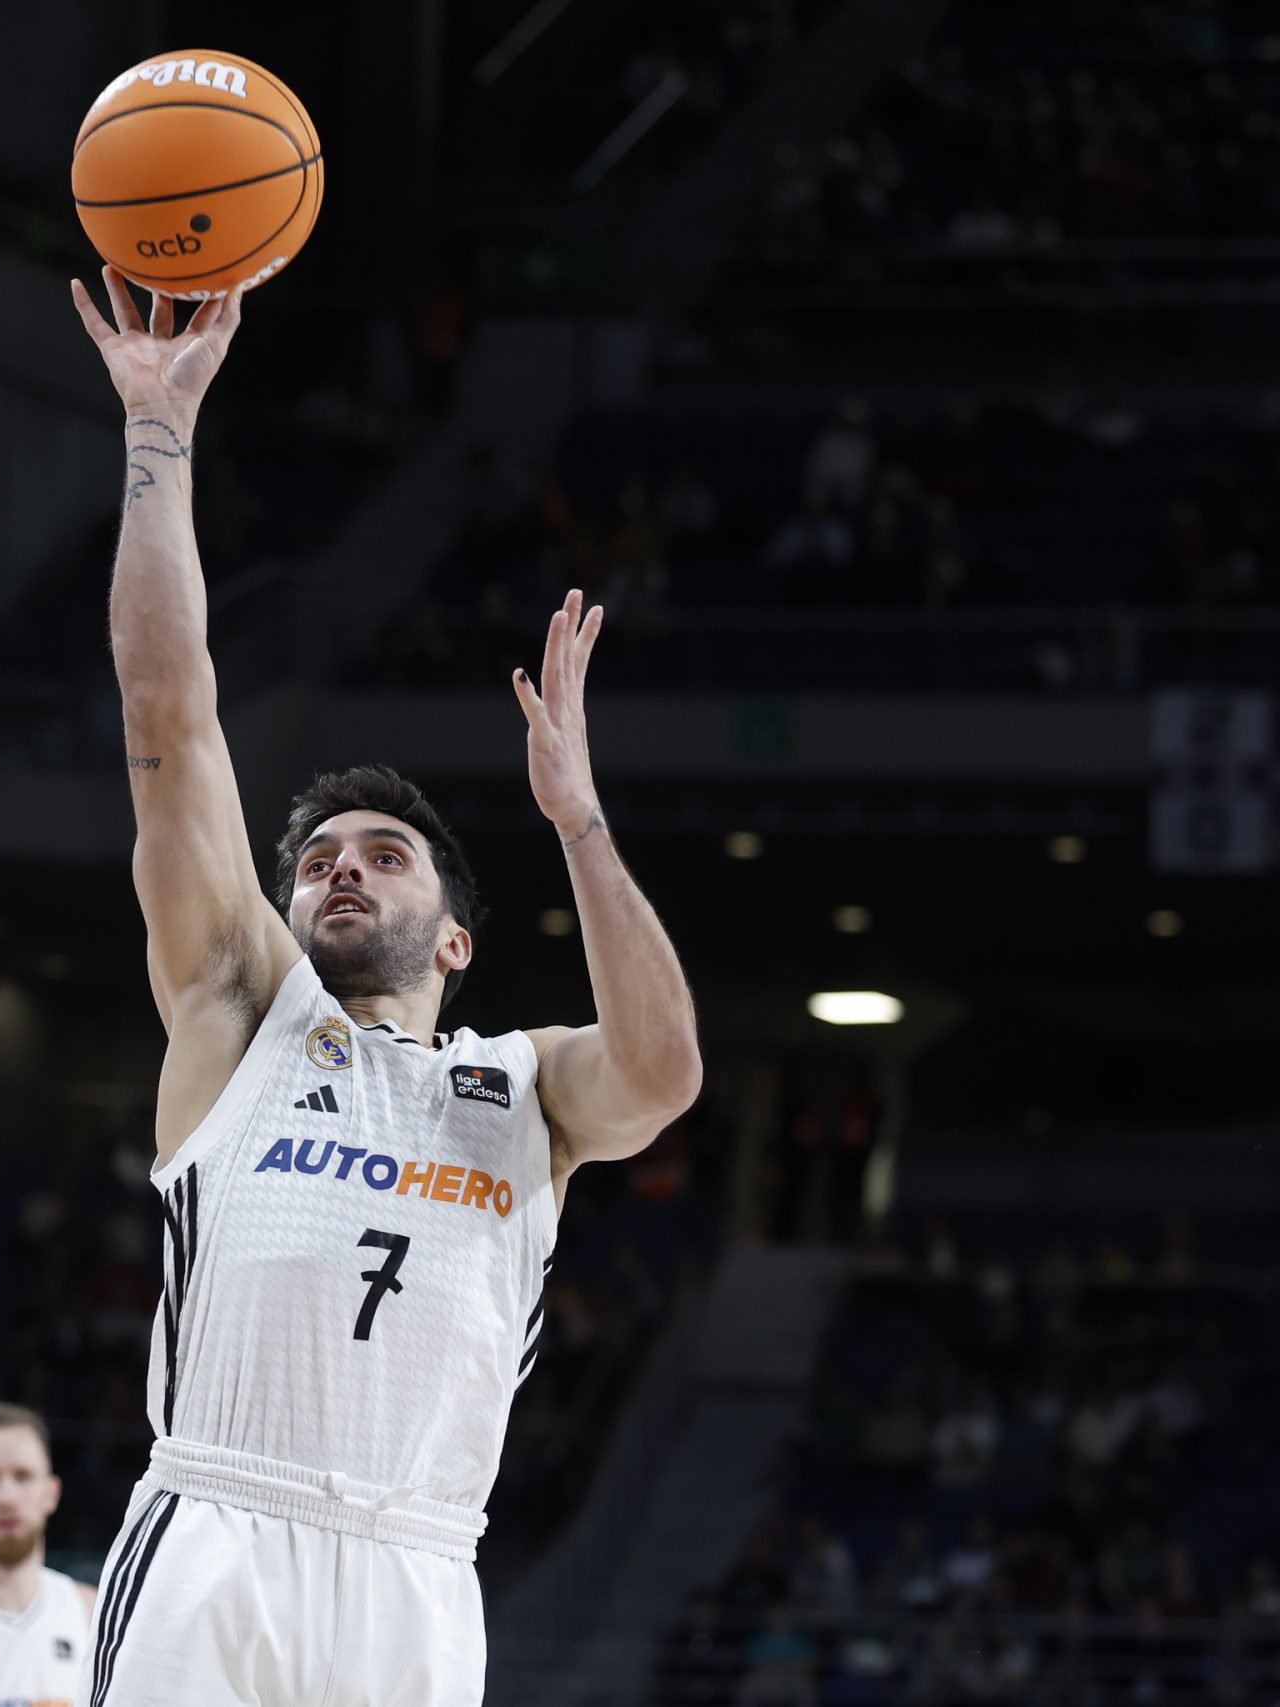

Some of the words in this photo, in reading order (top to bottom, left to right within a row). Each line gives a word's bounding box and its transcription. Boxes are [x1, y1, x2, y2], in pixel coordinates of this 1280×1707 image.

[136, 233, 202, 259] acb
[455, 1073, 481, 1087] liga
[457, 1085, 508, 1104] endesa
[254, 1138, 513, 1217] AUTOHERO
[353, 1227, 411, 1341] 7
